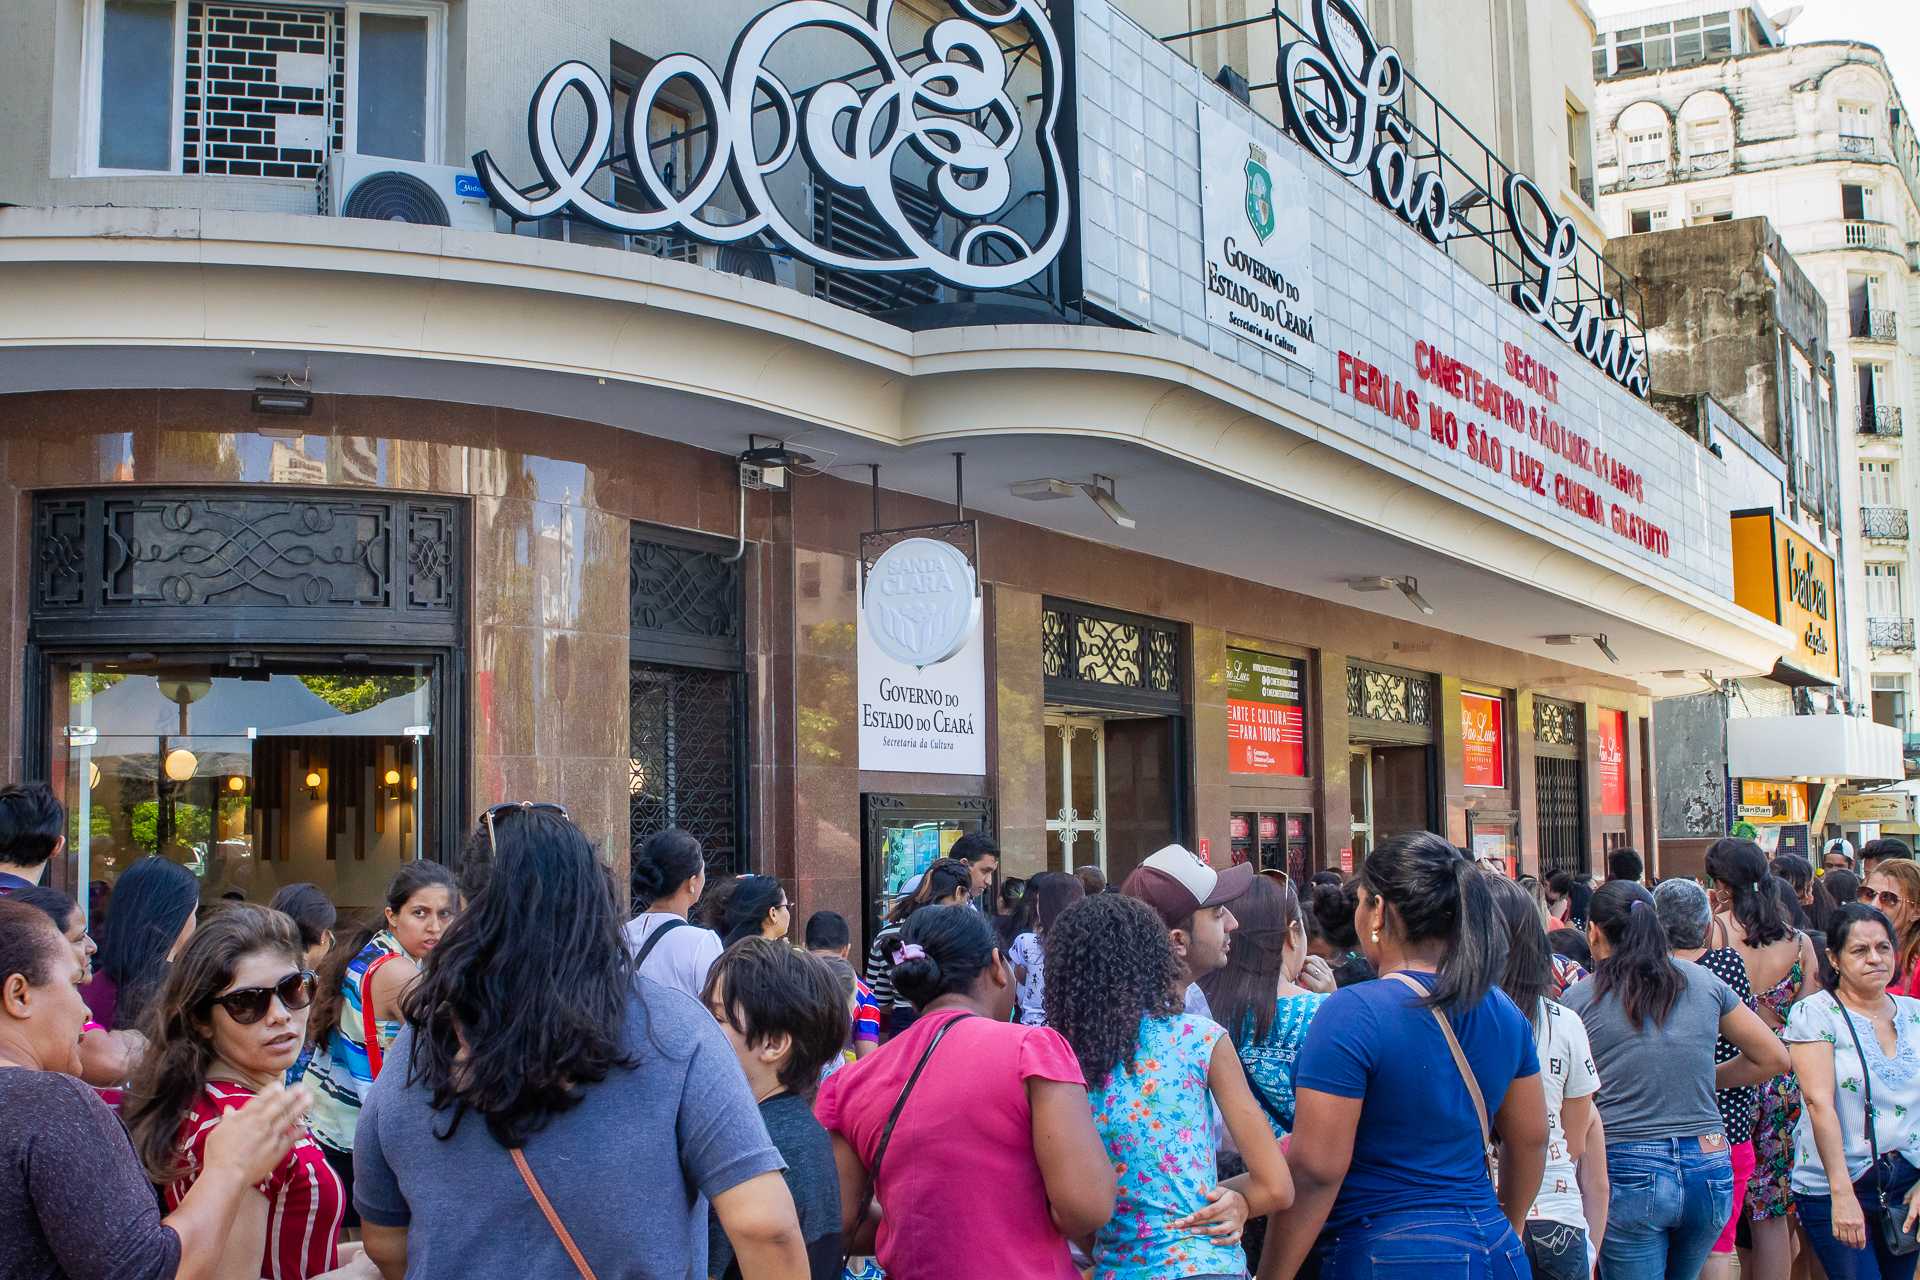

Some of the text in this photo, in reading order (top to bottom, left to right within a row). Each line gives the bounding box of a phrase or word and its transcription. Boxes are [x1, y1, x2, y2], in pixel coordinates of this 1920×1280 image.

[1224, 236, 1299, 302] GOVERNO DO
[1207, 260, 1315, 343] ESTADO DO CEARÁ
[1503, 173, 1650, 398] Luiz
[1229, 311, 1297, 354] Secretaria da Cultura
[1504, 341, 1559, 404] SECULT
[1415, 340, 1525, 433] CINETEATRO
[1594, 447, 1608, 482] 61
[1611, 458, 1643, 504] ANOS
[1338, 350, 1420, 430] FÉRIAS
[1430, 402, 1458, 450] NO
[1510, 446, 1546, 496] LUIZ
[1555, 473, 1606, 526] CINEMA
[1611, 503, 1669, 558] GRATUITO
[888, 556, 946, 575] SANTA
[881, 573, 953, 596] CLARA
[880, 678, 959, 707] GOVERNO DO
[863, 703, 974, 735] ESTADO DO CEARÁ
[1232, 705, 1287, 726] ARTE E CULTURA
[882, 736, 954, 750] Secretaria da Cultura
[1239, 724, 1280, 743] PARA TODOS
[1739, 806, 1771, 814] BanBan
